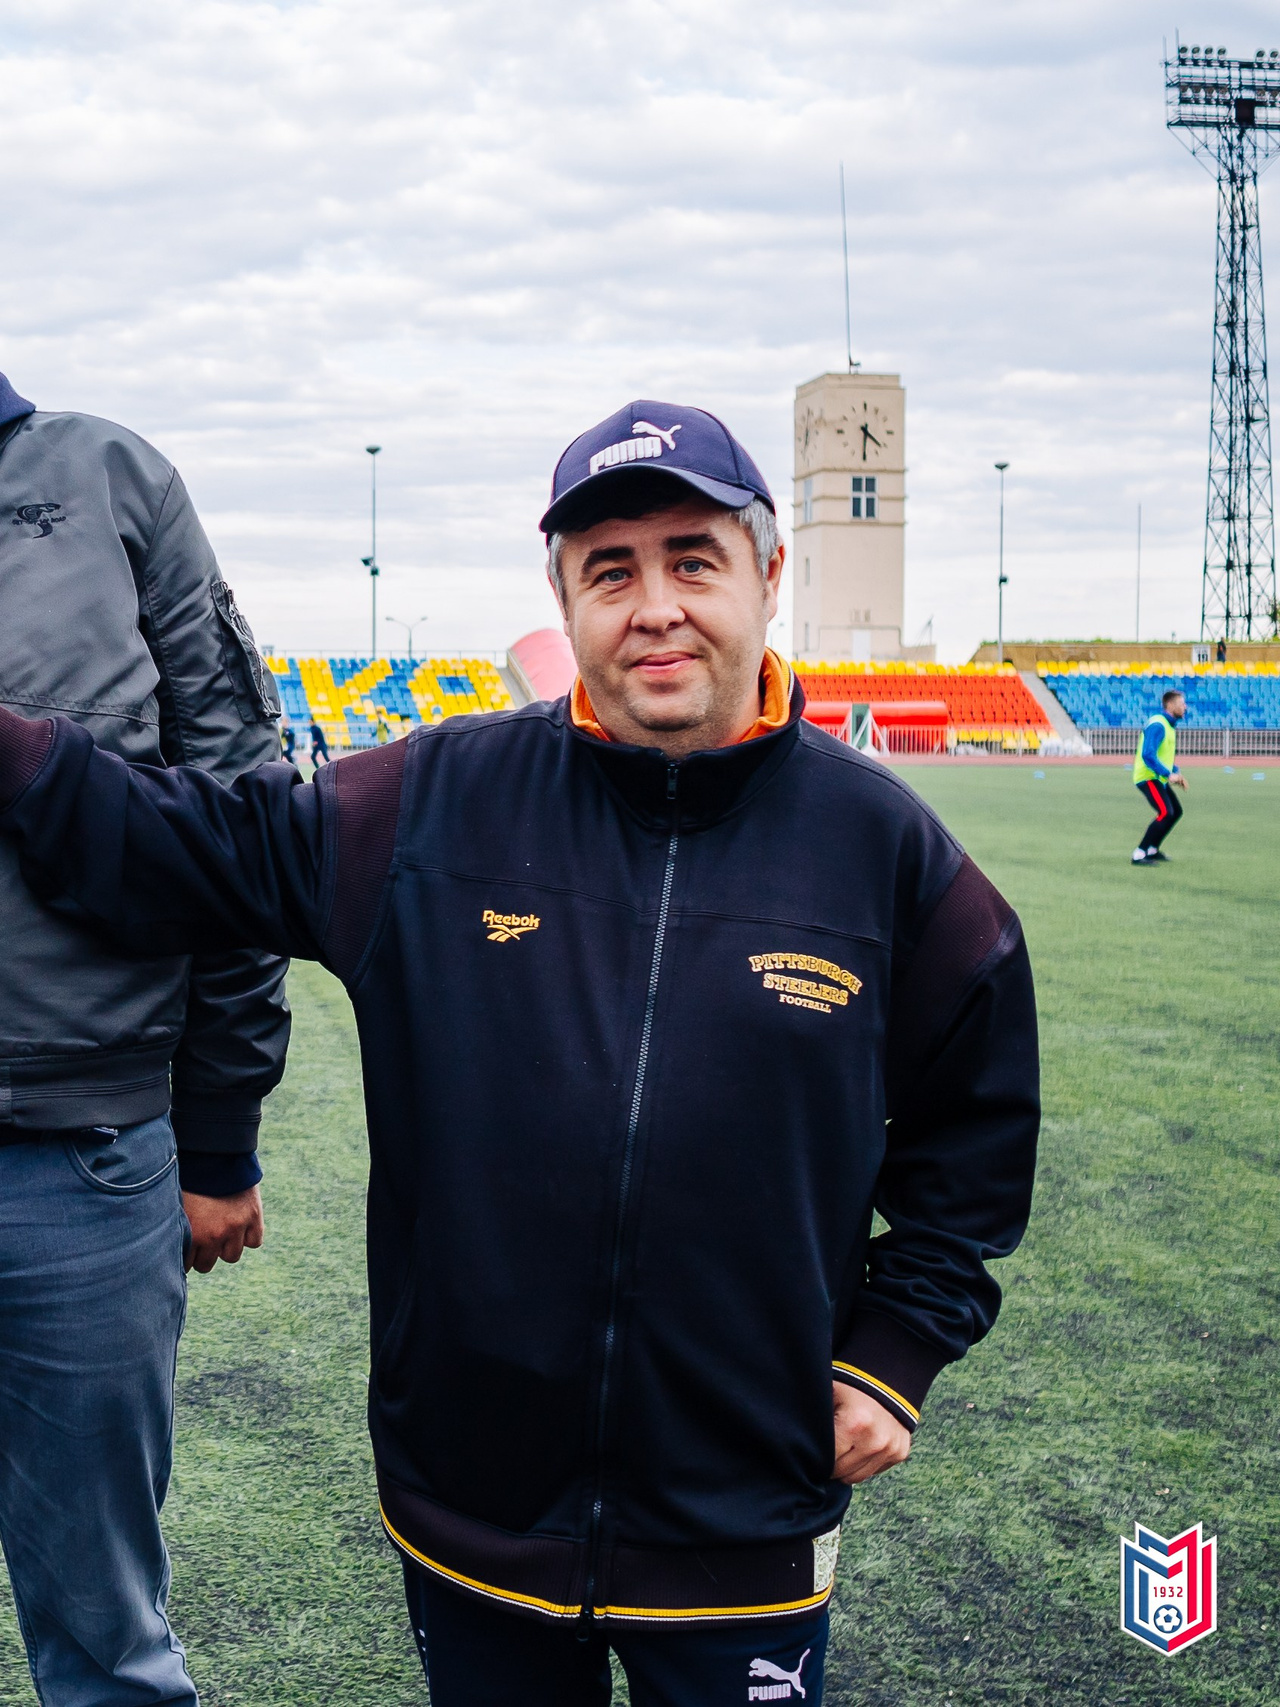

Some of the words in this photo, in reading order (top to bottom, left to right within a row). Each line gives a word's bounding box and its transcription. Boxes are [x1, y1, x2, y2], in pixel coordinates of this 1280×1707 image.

[589, 436, 663, 475] PUMA
[482, 909, 541, 928] Reebok
[748, 952, 863, 995] PITTSBURGH
[763, 972, 849, 1006] STEELERS
[778, 993, 832, 1013] FOOTBALL
[748, 1683, 791, 1701] PUMA
